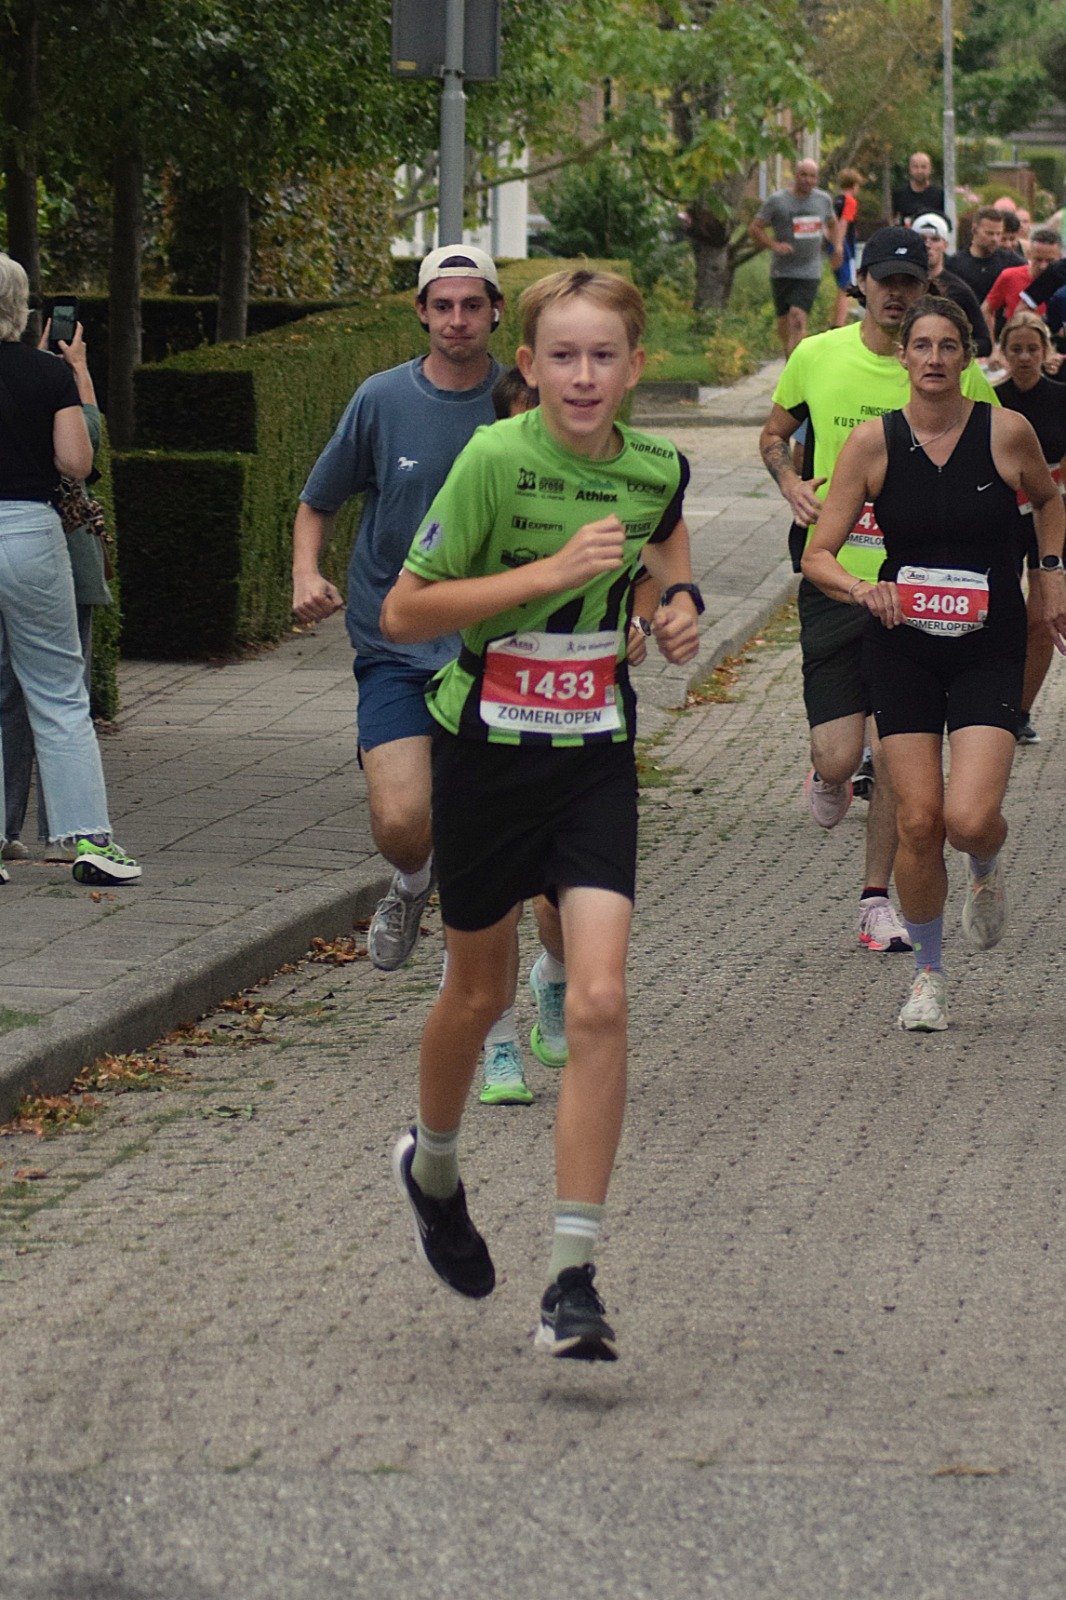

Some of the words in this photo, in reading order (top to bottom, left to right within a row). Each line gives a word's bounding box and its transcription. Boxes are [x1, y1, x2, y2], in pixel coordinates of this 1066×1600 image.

[833, 416, 866, 428] KUST
[575, 489, 617, 503] Athlex
[912, 592, 970, 616] 3408
[515, 669, 596, 700] 1433
[497, 705, 602, 725] ZOMERLOPEN
